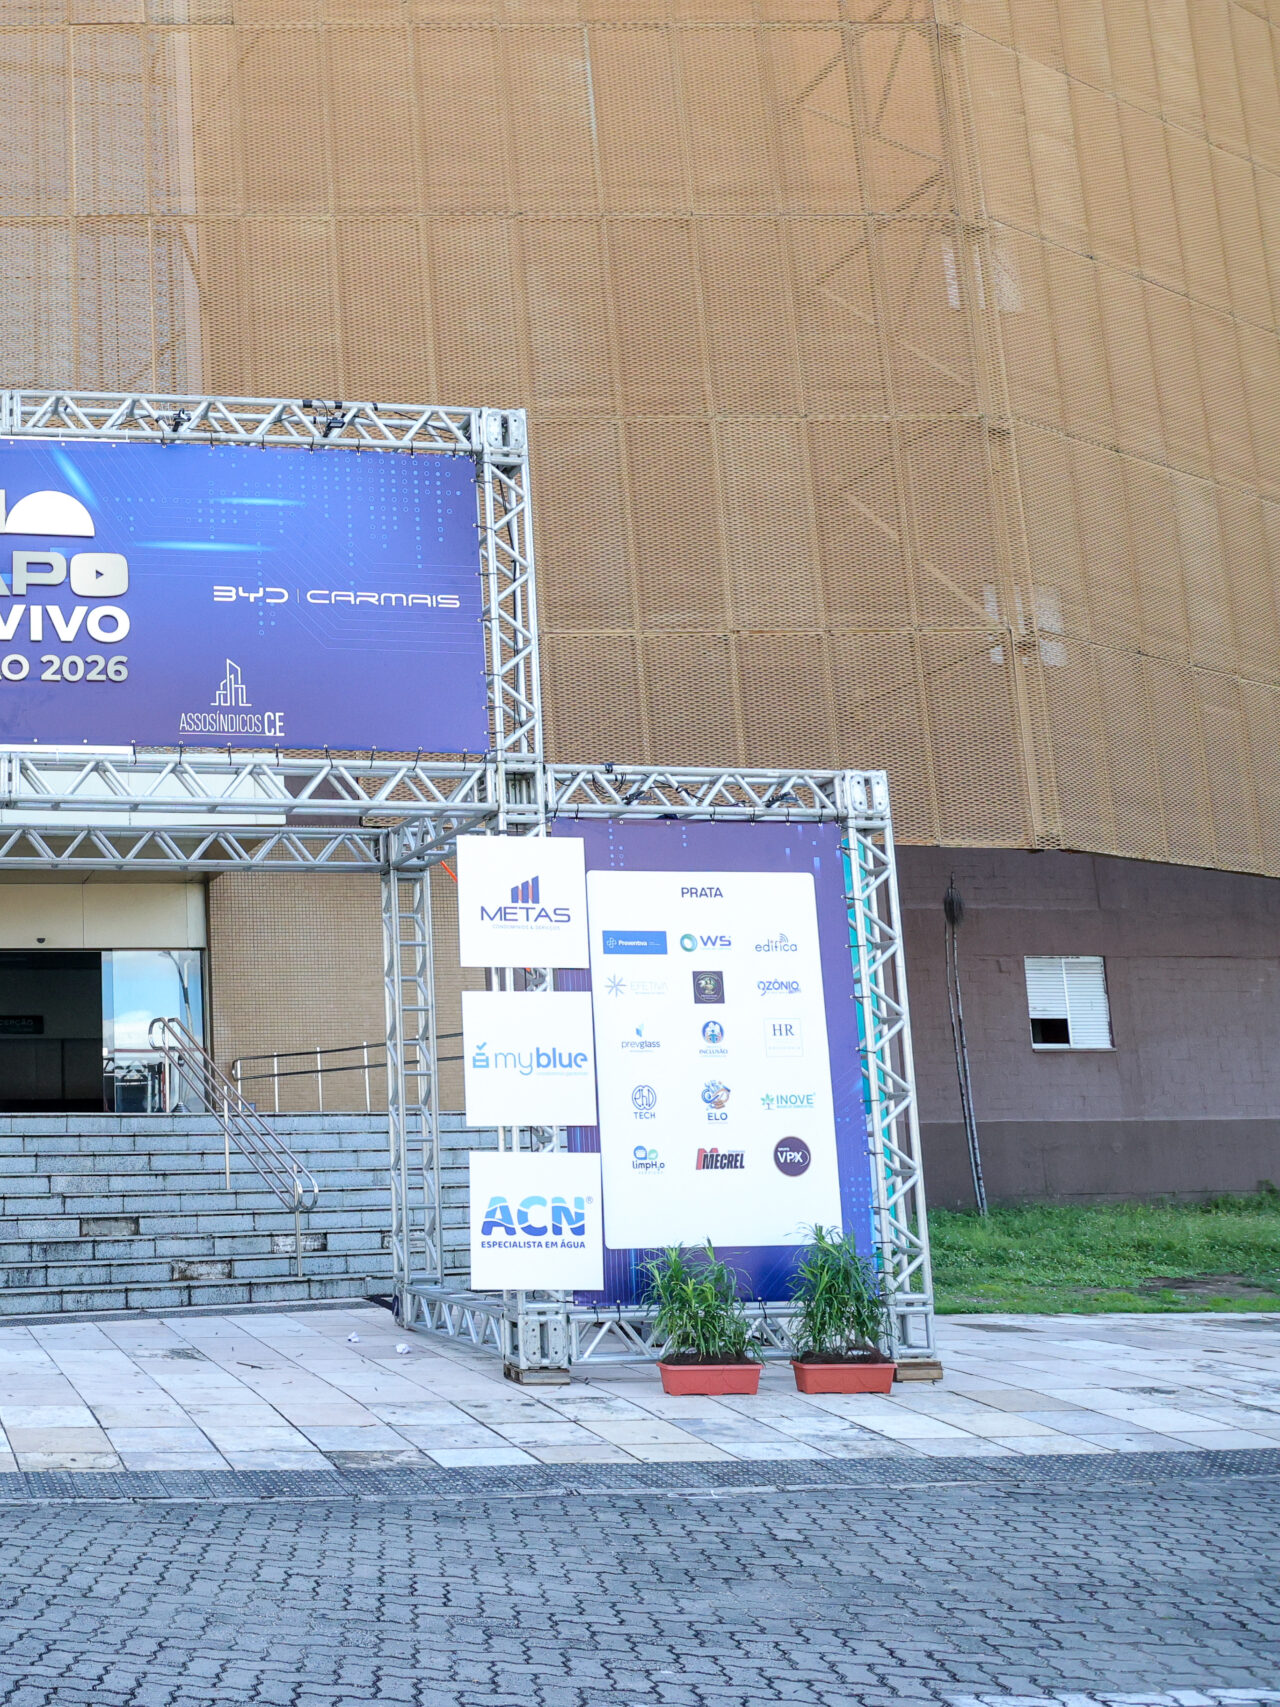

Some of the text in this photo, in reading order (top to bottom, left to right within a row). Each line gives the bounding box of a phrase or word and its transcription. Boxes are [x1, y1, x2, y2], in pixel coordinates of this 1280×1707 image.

[213, 586, 461, 608] BYD CARMAIS
[40, 654, 129, 683] 2026
[179, 711, 285, 736] ASSOSÍNDICOS CE
[681, 886, 724, 899] PRATA
[480, 905, 571, 923] METAS
[699, 935, 732, 947] WS
[754, 938, 798, 952] edifica
[772, 1023, 795, 1037] HR
[621, 1040, 661, 1049] prevglass
[494, 1047, 589, 1076] myblue
[776, 1094, 814, 1105] INOVE
[633, 1111, 656, 1120] TECH
[707, 1112, 728, 1121] ELO
[702, 1153, 745, 1170] MECREL
[777, 1152, 803, 1163] VPX
[480, 1195, 586, 1237] ACN
[480, 1240, 543, 1248] ESPECIALISTA
[560, 1238, 586, 1249] ÁGUA
